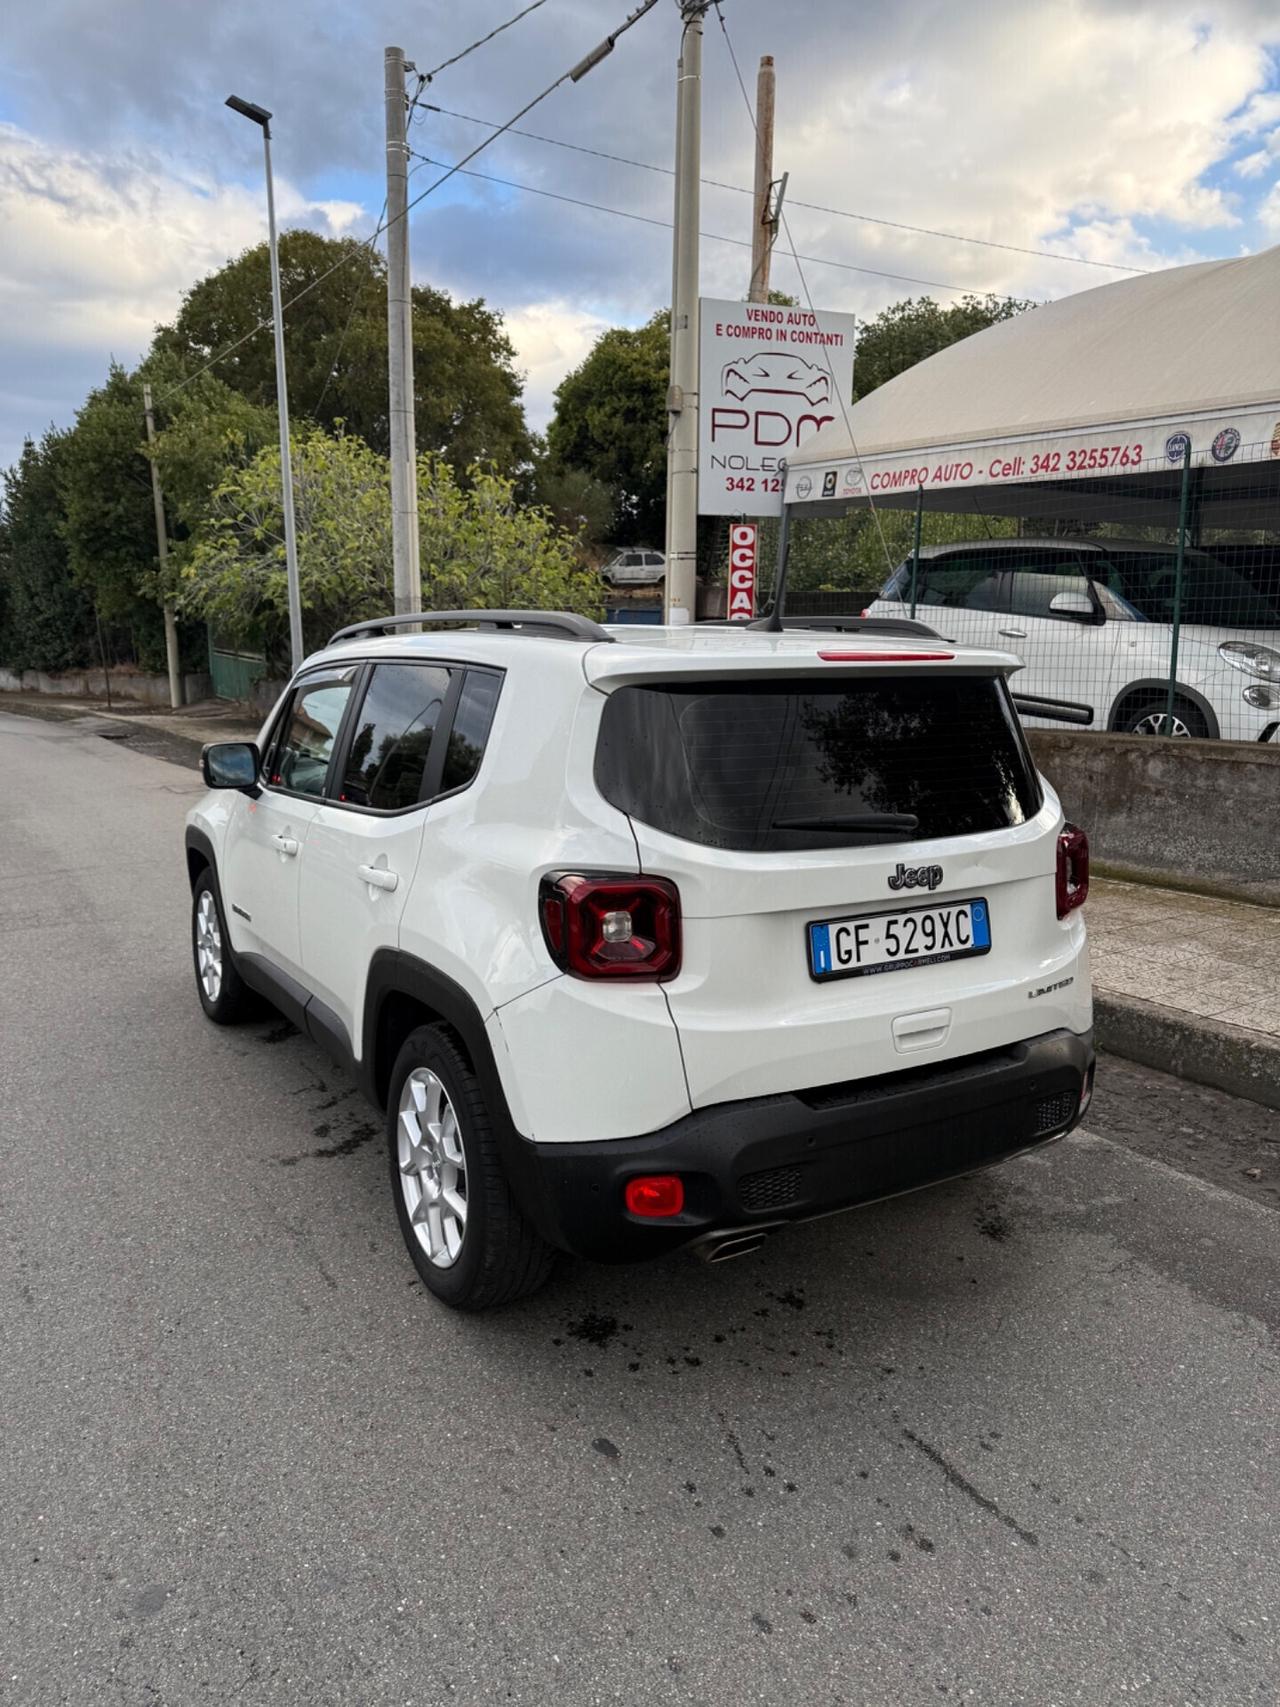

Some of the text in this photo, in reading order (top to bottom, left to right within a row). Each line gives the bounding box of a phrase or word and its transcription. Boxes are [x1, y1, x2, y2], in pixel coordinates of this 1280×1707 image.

[746, 308, 816, 327] VENDO AUTO
[716, 323, 844, 347] E COMPRO IN CONTANTI
[870, 466, 929, 490] COMPRO
[931, 462, 974, 482] AUTO
[989, 456, 1025, 479] Cell:
[1030, 452, 1061, 475] 342
[1066, 444, 1143, 471] 3255763
[725, 476, 756, 492] 342
[888, 864, 943, 890] Jeep
[835, 909, 970, 965] GF 529XC
[1028, 976, 1074, 999] LIMITED
